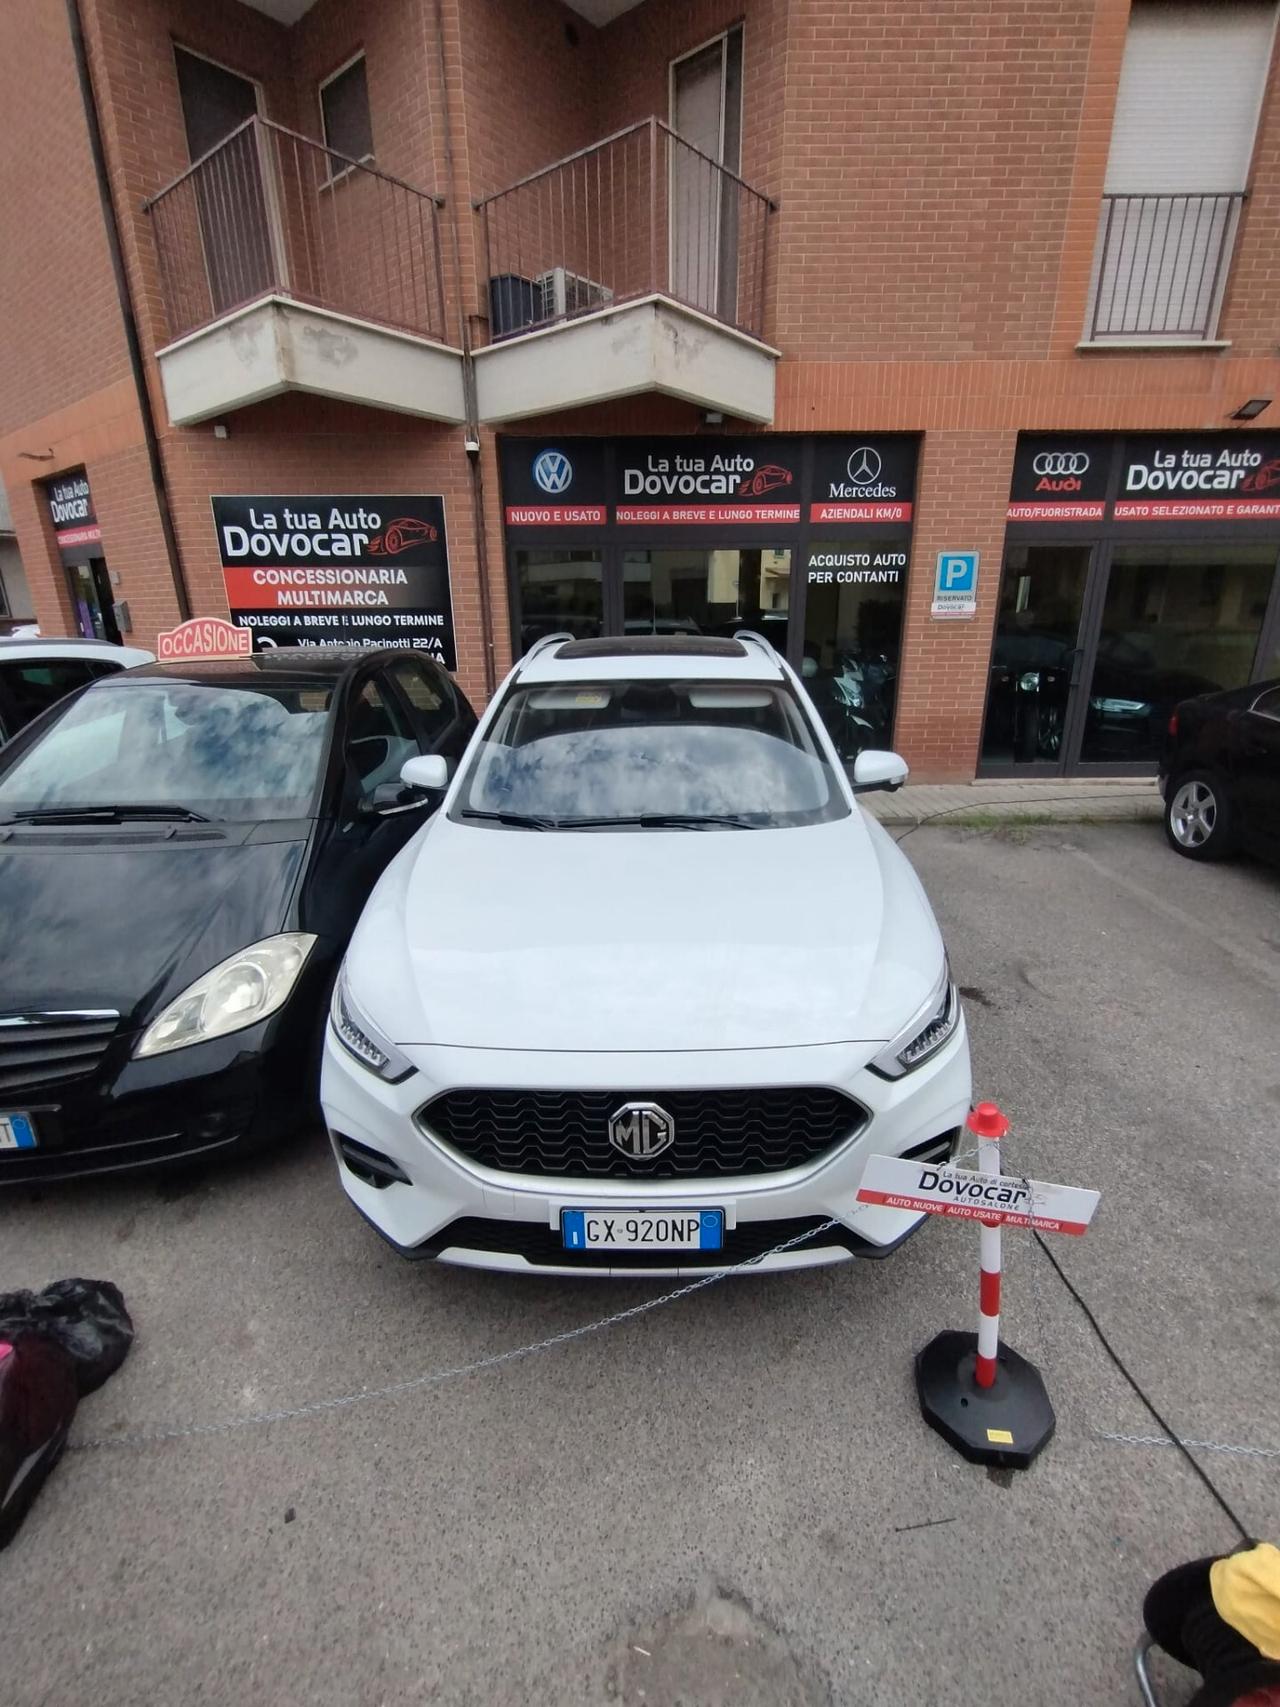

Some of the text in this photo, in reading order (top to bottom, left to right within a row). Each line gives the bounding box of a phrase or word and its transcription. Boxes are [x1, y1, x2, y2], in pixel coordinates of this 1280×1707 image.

[647, 454, 754, 472] La tua Auto
[1155, 449, 1262, 467] La tua Auto
[624, 469, 740, 495] Dovocar
[1035, 476, 1082, 491] Audi
[1126, 464, 1245, 491] Dovocar
[54, 487, 64, 502] La
[73, 480, 90, 497] Auto
[829, 482, 897, 498] Mercedes
[50, 498, 88, 523] Dovocar
[511, 510, 601, 522] NUOVO E USATO
[616, 509, 800, 520] NOLEGGI A BREVE E LUNGO TERMINE
[820, 508, 873, 519] AZIENDALI
[1006, 507, 1103, 518] AUTO/FUORISTRADA
[1114, 504, 1149, 516] USATO
[1152, 505, 1224, 516] SELEZIONATO
[1226, 505, 1235, 515] E
[249, 508, 382, 530] La tua Auto
[223, 525, 369, 557] Dovocar
[808, 554, 907, 567] ACQUISTO AUTO
[253, 570, 408, 585] CONCESSIONARIA
[808, 571, 899, 583] PER CONTANTI
[946, 560, 967, 587] P
[277, 591, 389, 606] MULTIMARCA
[239, 616, 291, 626] NOLEGGI
[293, 616, 302, 626] A
[304, 615, 340, 626] BREVE
[351, 616, 392, 626] LUNGO
[393, 615, 444, 626] TERMINE
[162, 624, 248, 655] OCCASIONE
[297, 638, 317, 647] Via
[362, 638, 410, 649] Pacinotti
[412, 637, 443, 649] 22/A
[615, 1110, 668, 1155] MG
[943, 1170, 953, 1178] La
[955, 1171, 968, 1180] tua
[970, 1175, 988, 1184] Auto
[918, 1171, 1026, 1204] Dovocar
[886, 1197, 911, 1208] AUTO
[912, 1200, 943, 1213] NUOVE
[947, 1206, 972, 1217] AUTO
[972, 1210, 1002, 1221] USATE
[953, 1196, 1020, 1211] AUTOSALONE
[587, 1220, 615, 1241] GX
[626, 1219, 700, 1241] 920NP
